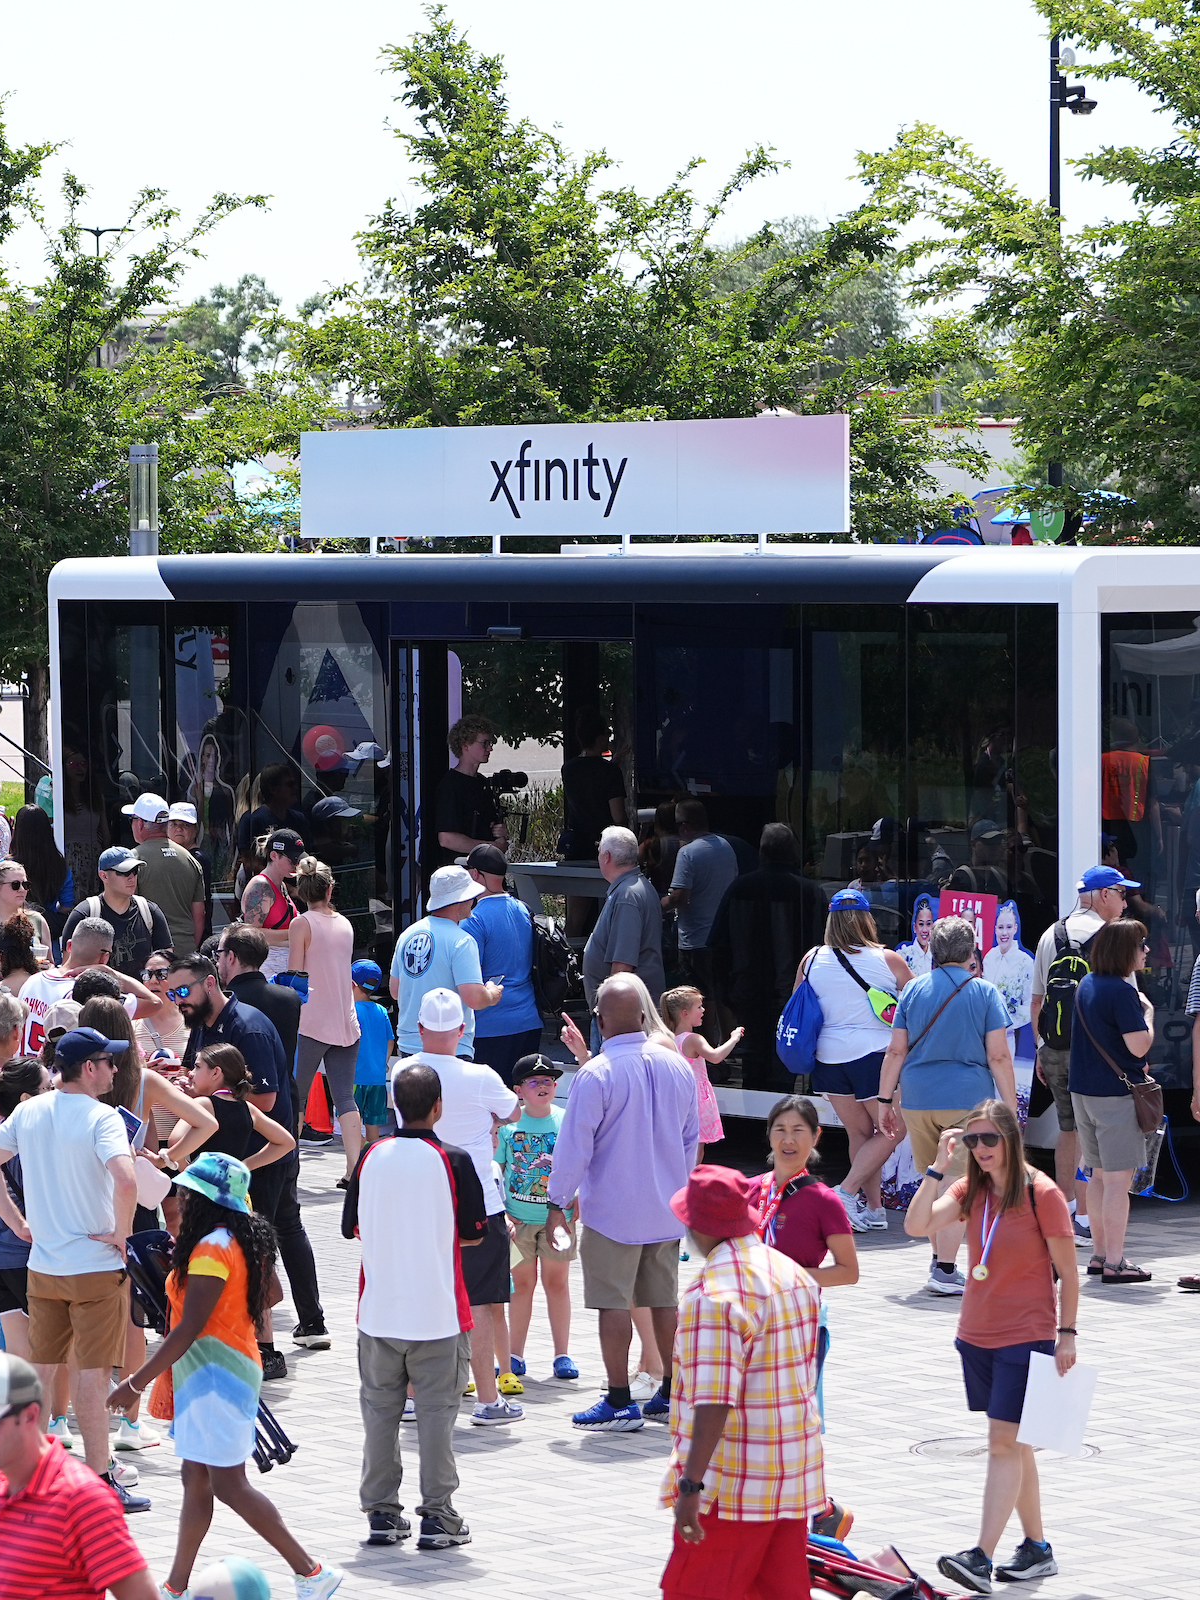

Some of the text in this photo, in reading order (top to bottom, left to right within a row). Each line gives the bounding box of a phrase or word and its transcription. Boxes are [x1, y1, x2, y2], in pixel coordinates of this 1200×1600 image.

[490, 440, 628, 519] xfinity
[23, 997, 50, 1019] OHNSO
[511, 1191, 550, 1204] MINECRA
[614, 1409, 630, 1418] HOKA
